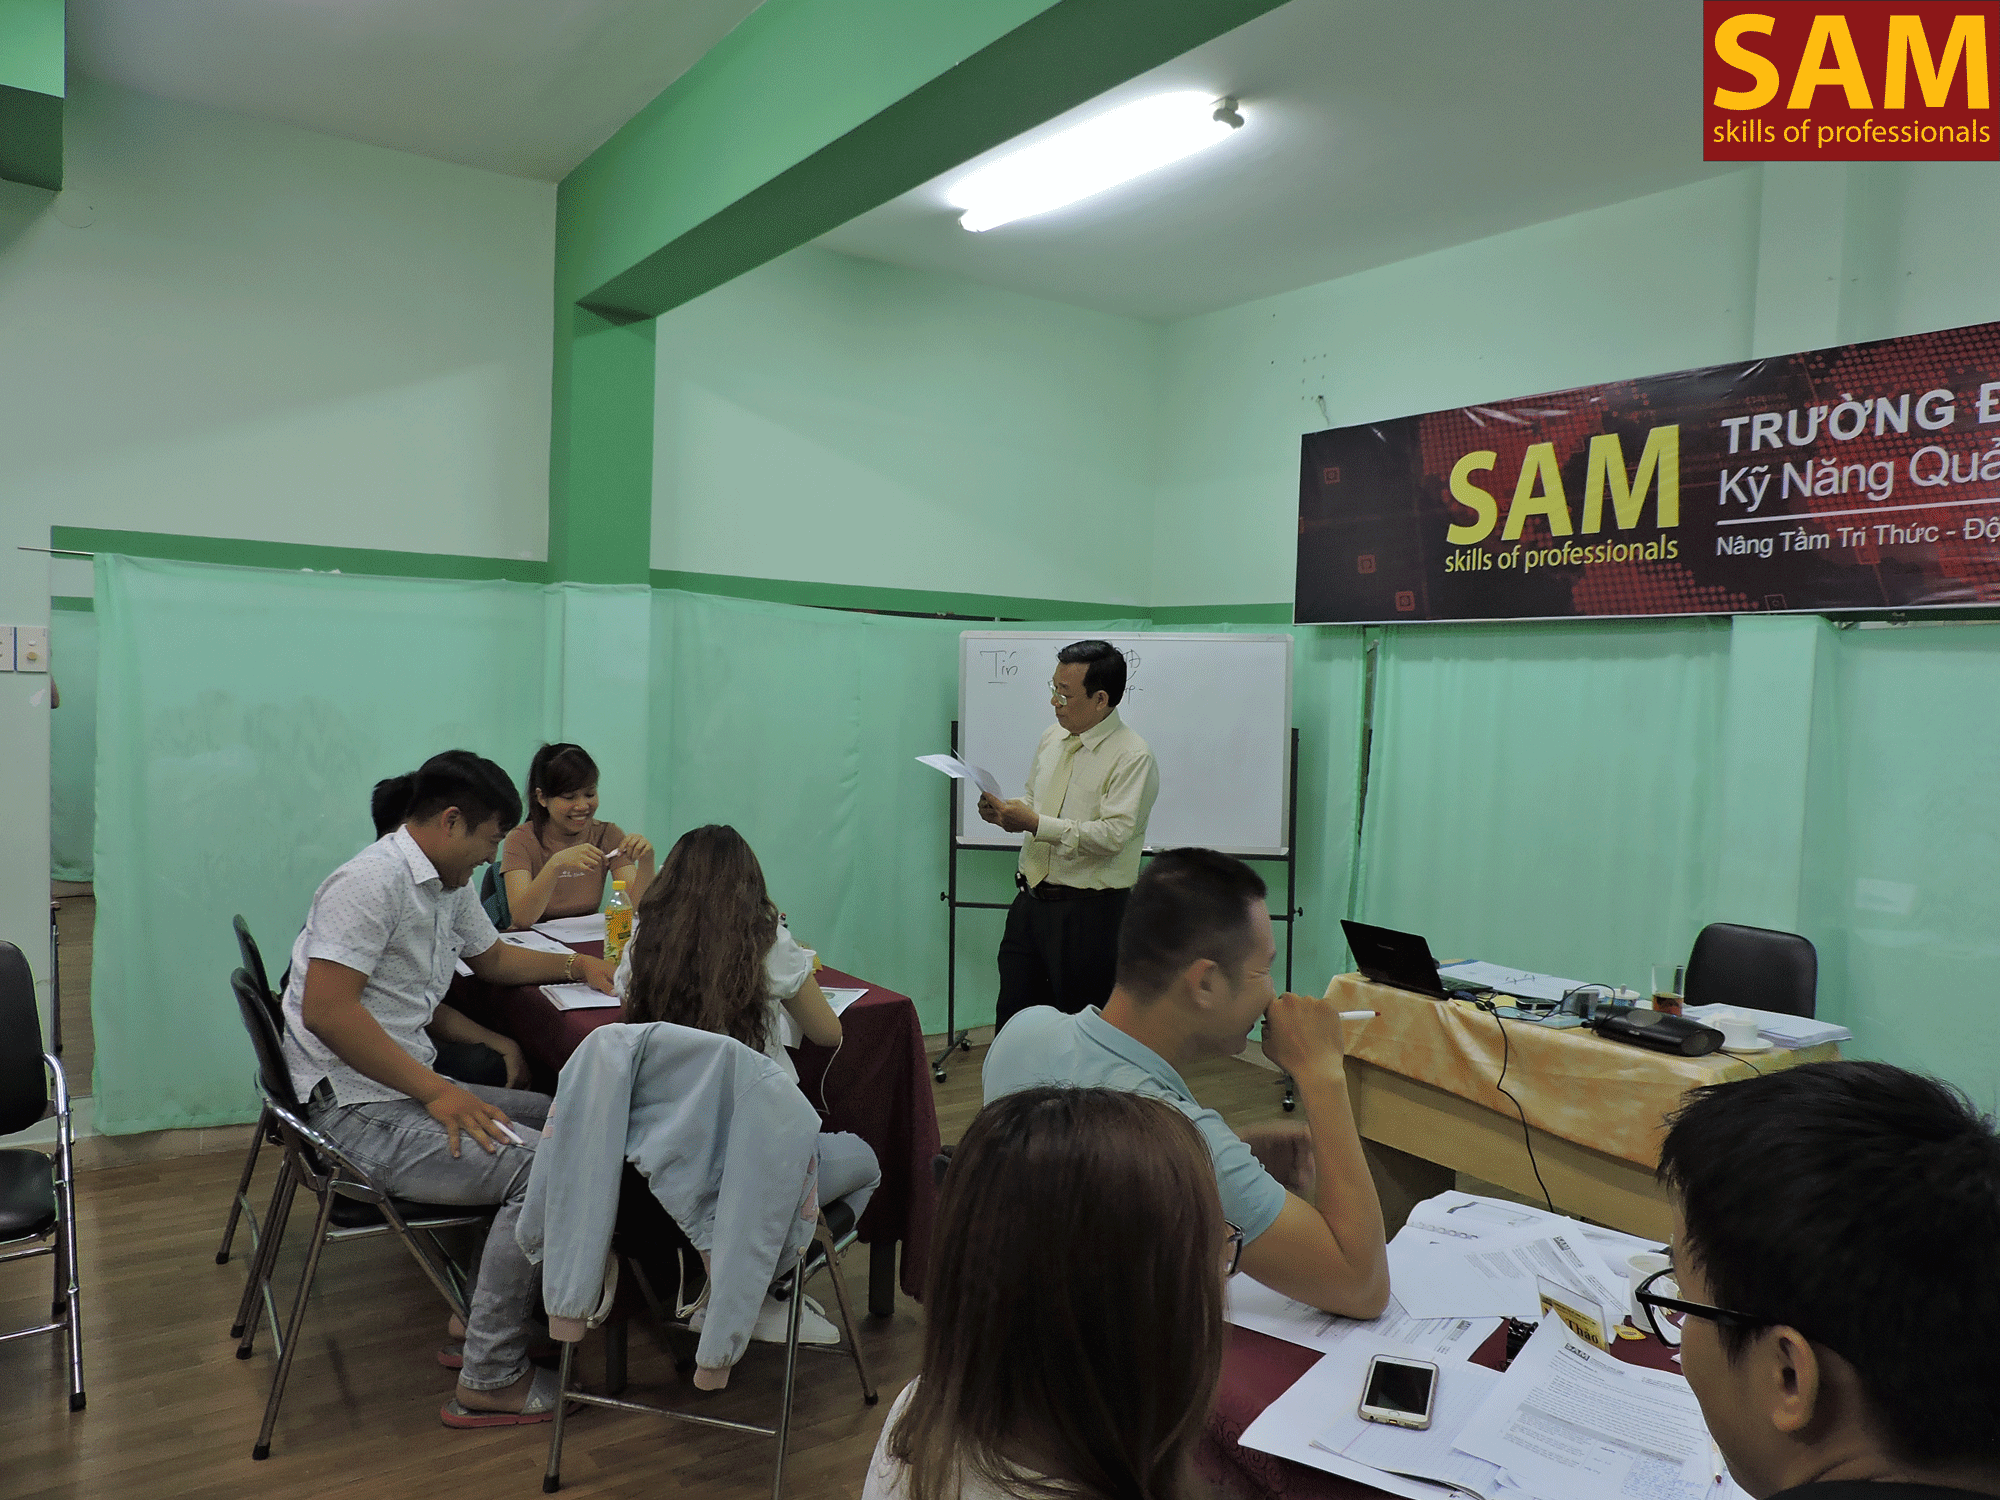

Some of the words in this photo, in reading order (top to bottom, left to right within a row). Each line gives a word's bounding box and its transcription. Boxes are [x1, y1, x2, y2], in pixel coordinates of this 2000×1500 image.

[1721, 388, 1955, 454] TRƯỜNG
[1446, 423, 1680, 545] SAM
[1719, 464, 1771, 513] Kỹ
[1782, 457, 1895, 501] Năng
[1445, 547, 1493, 573] skills
[1497, 544, 1522, 571] of
[1524, 533, 1679, 574] professionals
[1716, 535, 1774, 559] Nâng
[1779, 526, 1830, 552] Tầm
[1837, 526, 1867, 548] Tri
[1873, 522, 1939, 546] Thức
